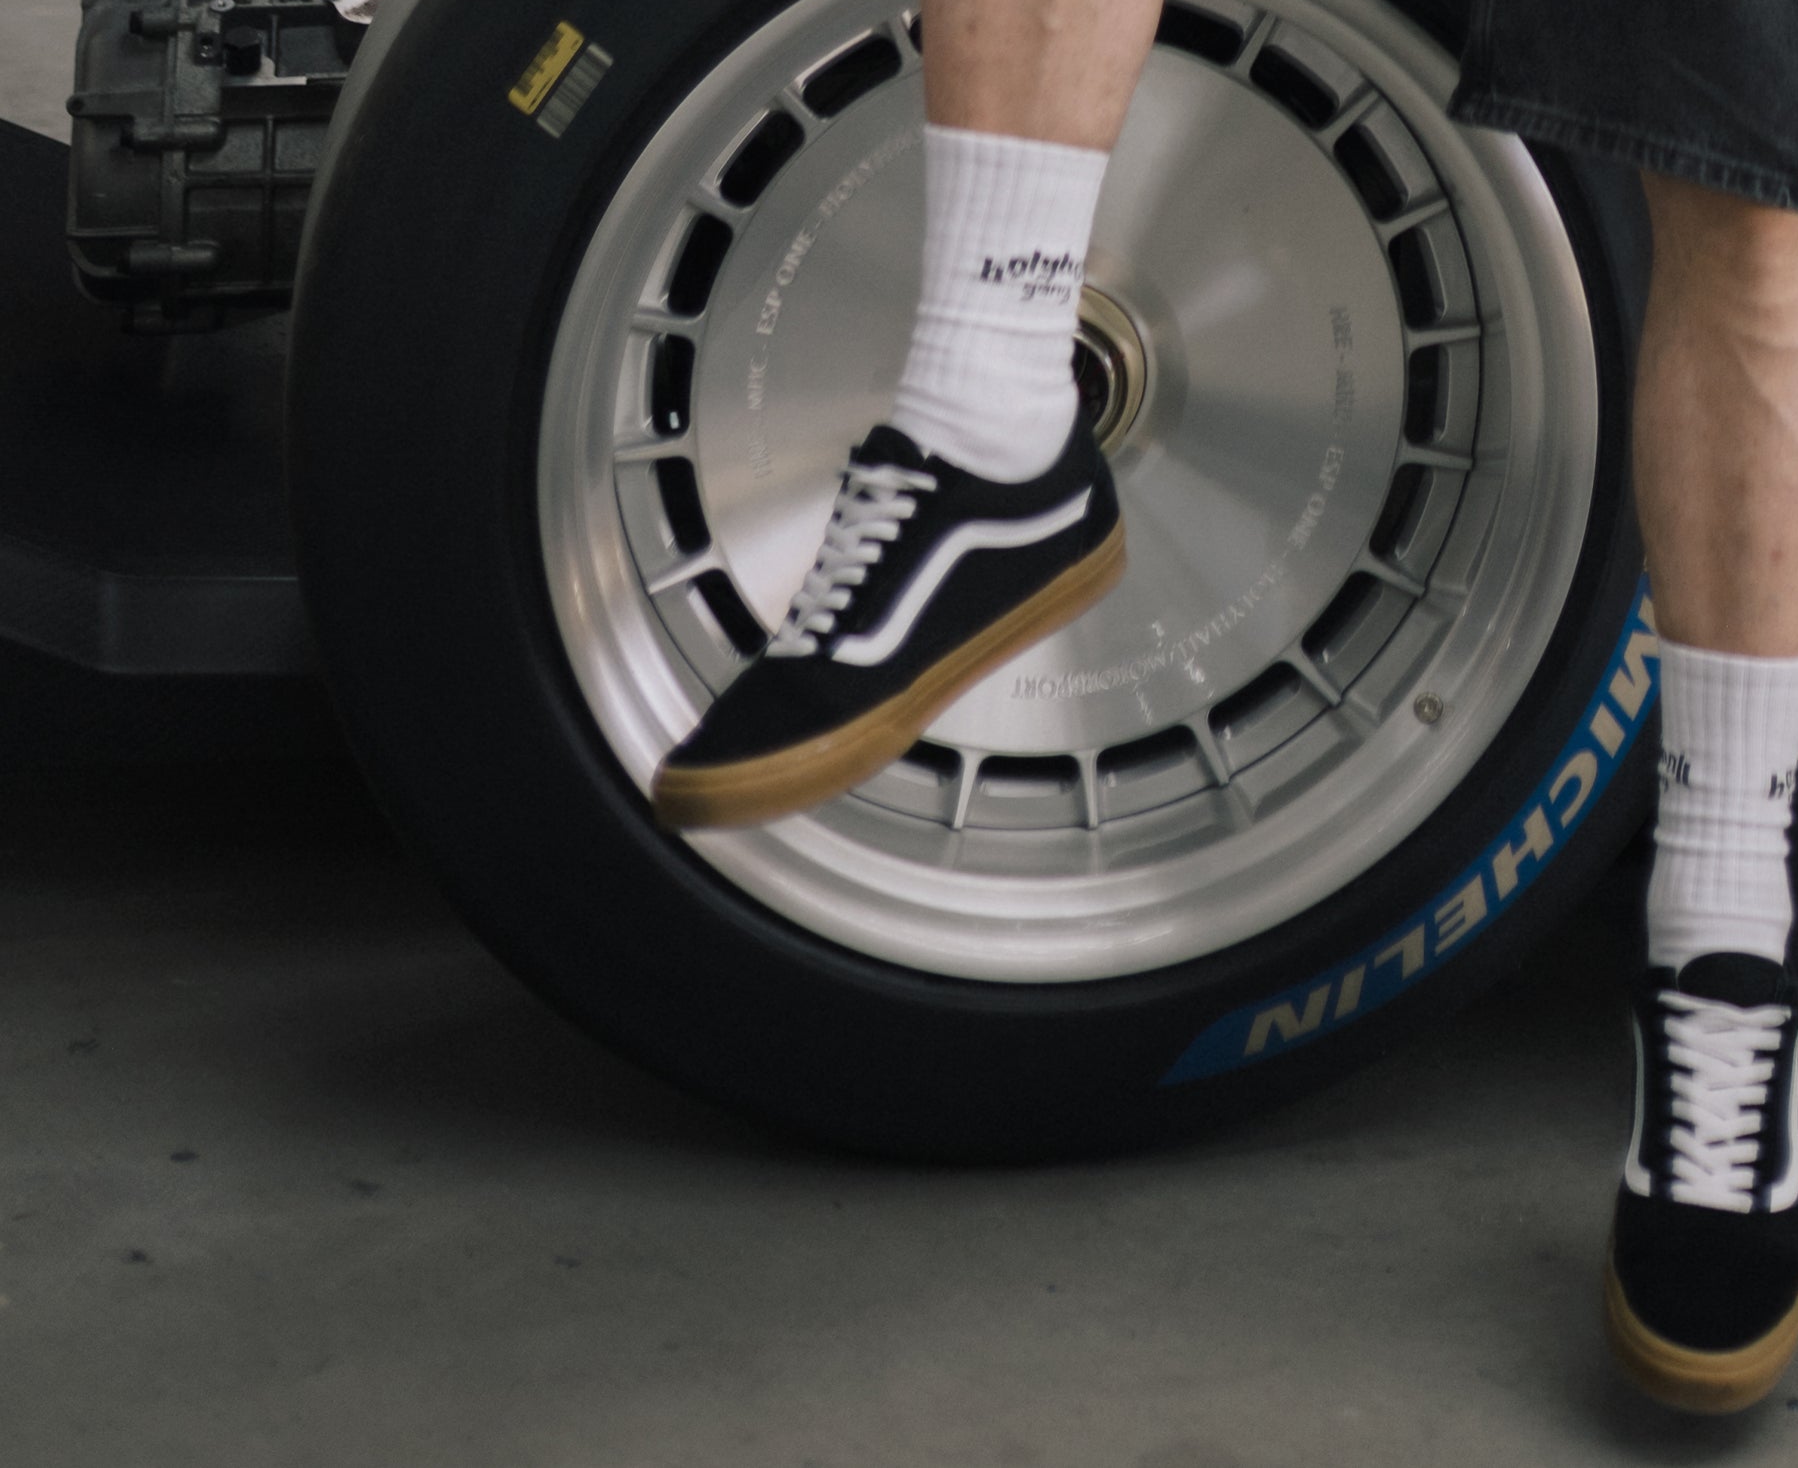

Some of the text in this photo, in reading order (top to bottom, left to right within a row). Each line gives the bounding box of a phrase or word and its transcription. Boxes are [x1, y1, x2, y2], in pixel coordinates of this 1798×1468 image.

[756, 287, 783, 336] ESP
[775, 227, 817, 286] ONE
[1243, 593, 1661, 1057] MICHELIN
